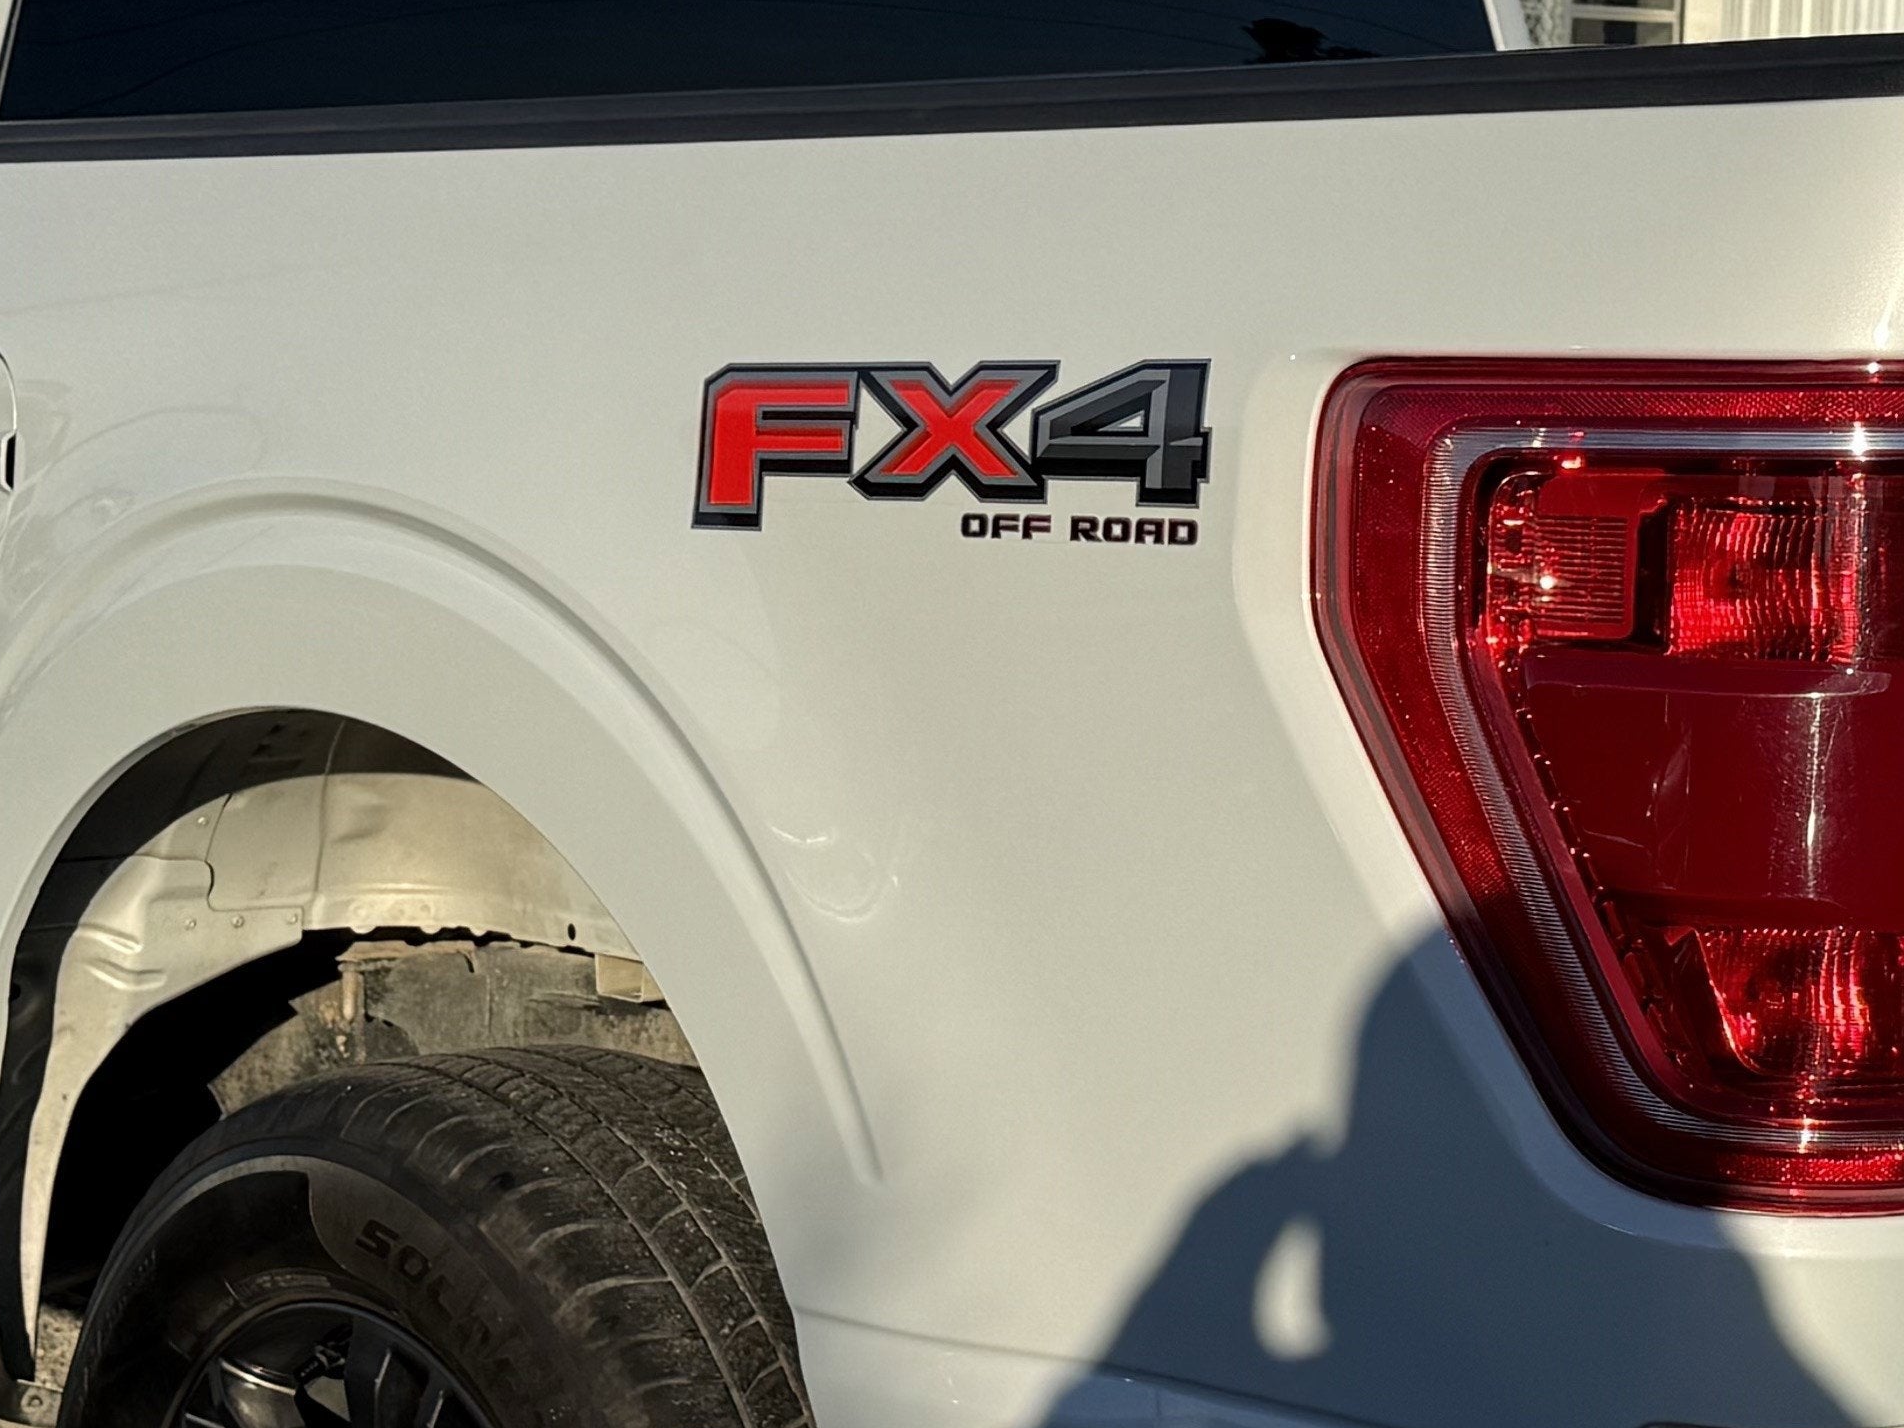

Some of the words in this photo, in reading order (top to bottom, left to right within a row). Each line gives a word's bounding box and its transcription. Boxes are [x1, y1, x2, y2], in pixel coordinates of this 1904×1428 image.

[692, 358, 1212, 531] FX4
[960, 512, 1052, 541] OFF
[1069, 514, 1199, 546] ROAD
